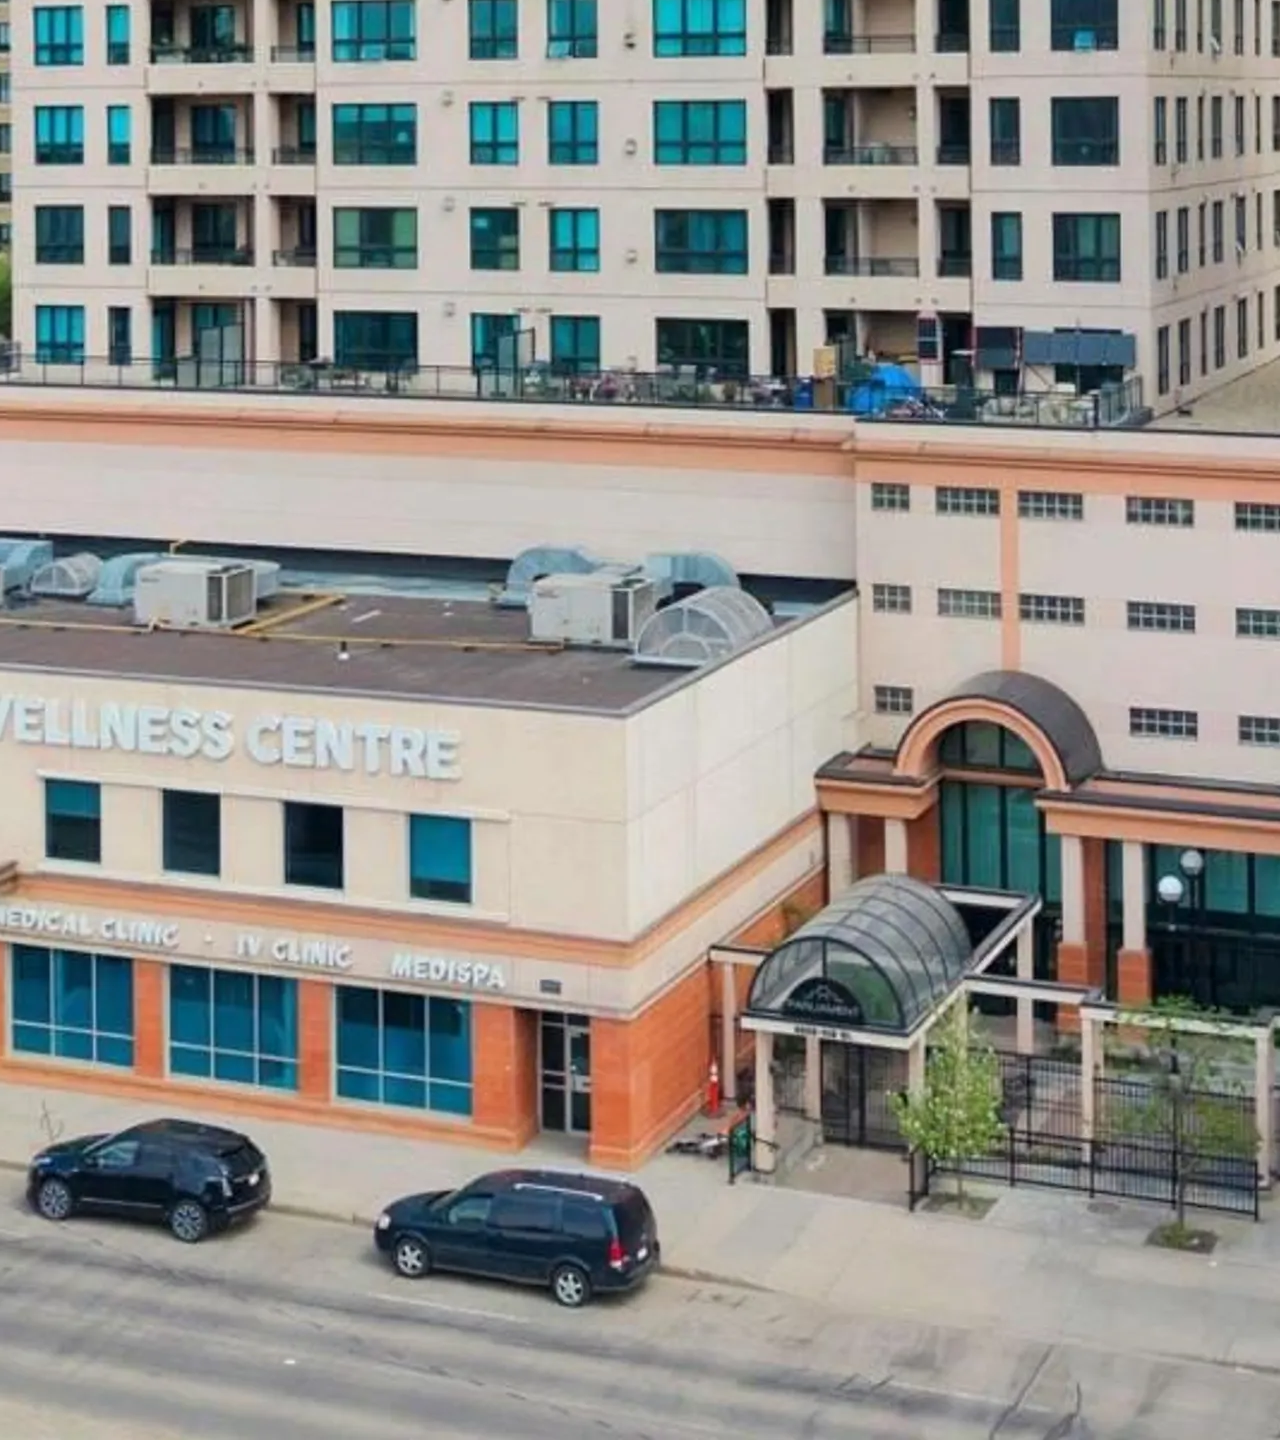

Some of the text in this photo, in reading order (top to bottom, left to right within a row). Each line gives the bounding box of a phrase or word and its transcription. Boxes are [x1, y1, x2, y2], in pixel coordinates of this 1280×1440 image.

[245, 712, 462, 781] CENTRE
[101, 918, 180, 949] CLINIC
[236, 933, 354, 969] IV CLINIC
[390, 952, 507, 989] MEDISPA
